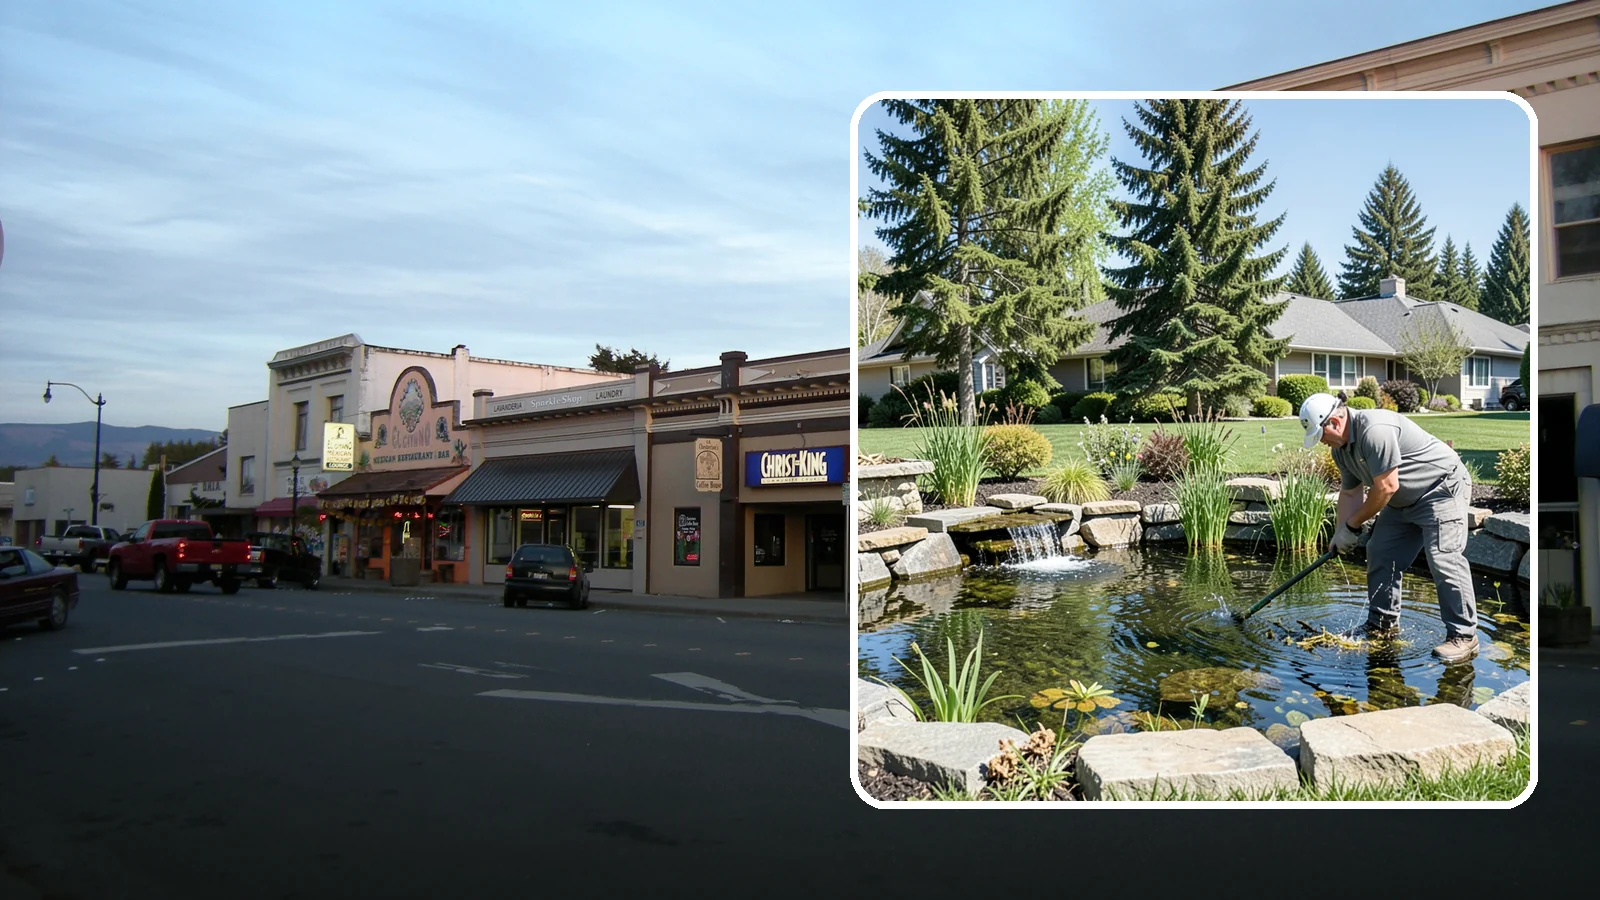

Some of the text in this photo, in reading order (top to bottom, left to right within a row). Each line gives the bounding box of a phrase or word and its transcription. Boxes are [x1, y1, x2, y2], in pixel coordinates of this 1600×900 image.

[562, 394, 582, 406] Shop
[596, 389, 623, 400] LAUNDRY
[494, 402, 522, 412] LAVANDERIA
[374, 455, 396, 463] MEXICAN
[398, 451, 433, 462] RESTAURANT
